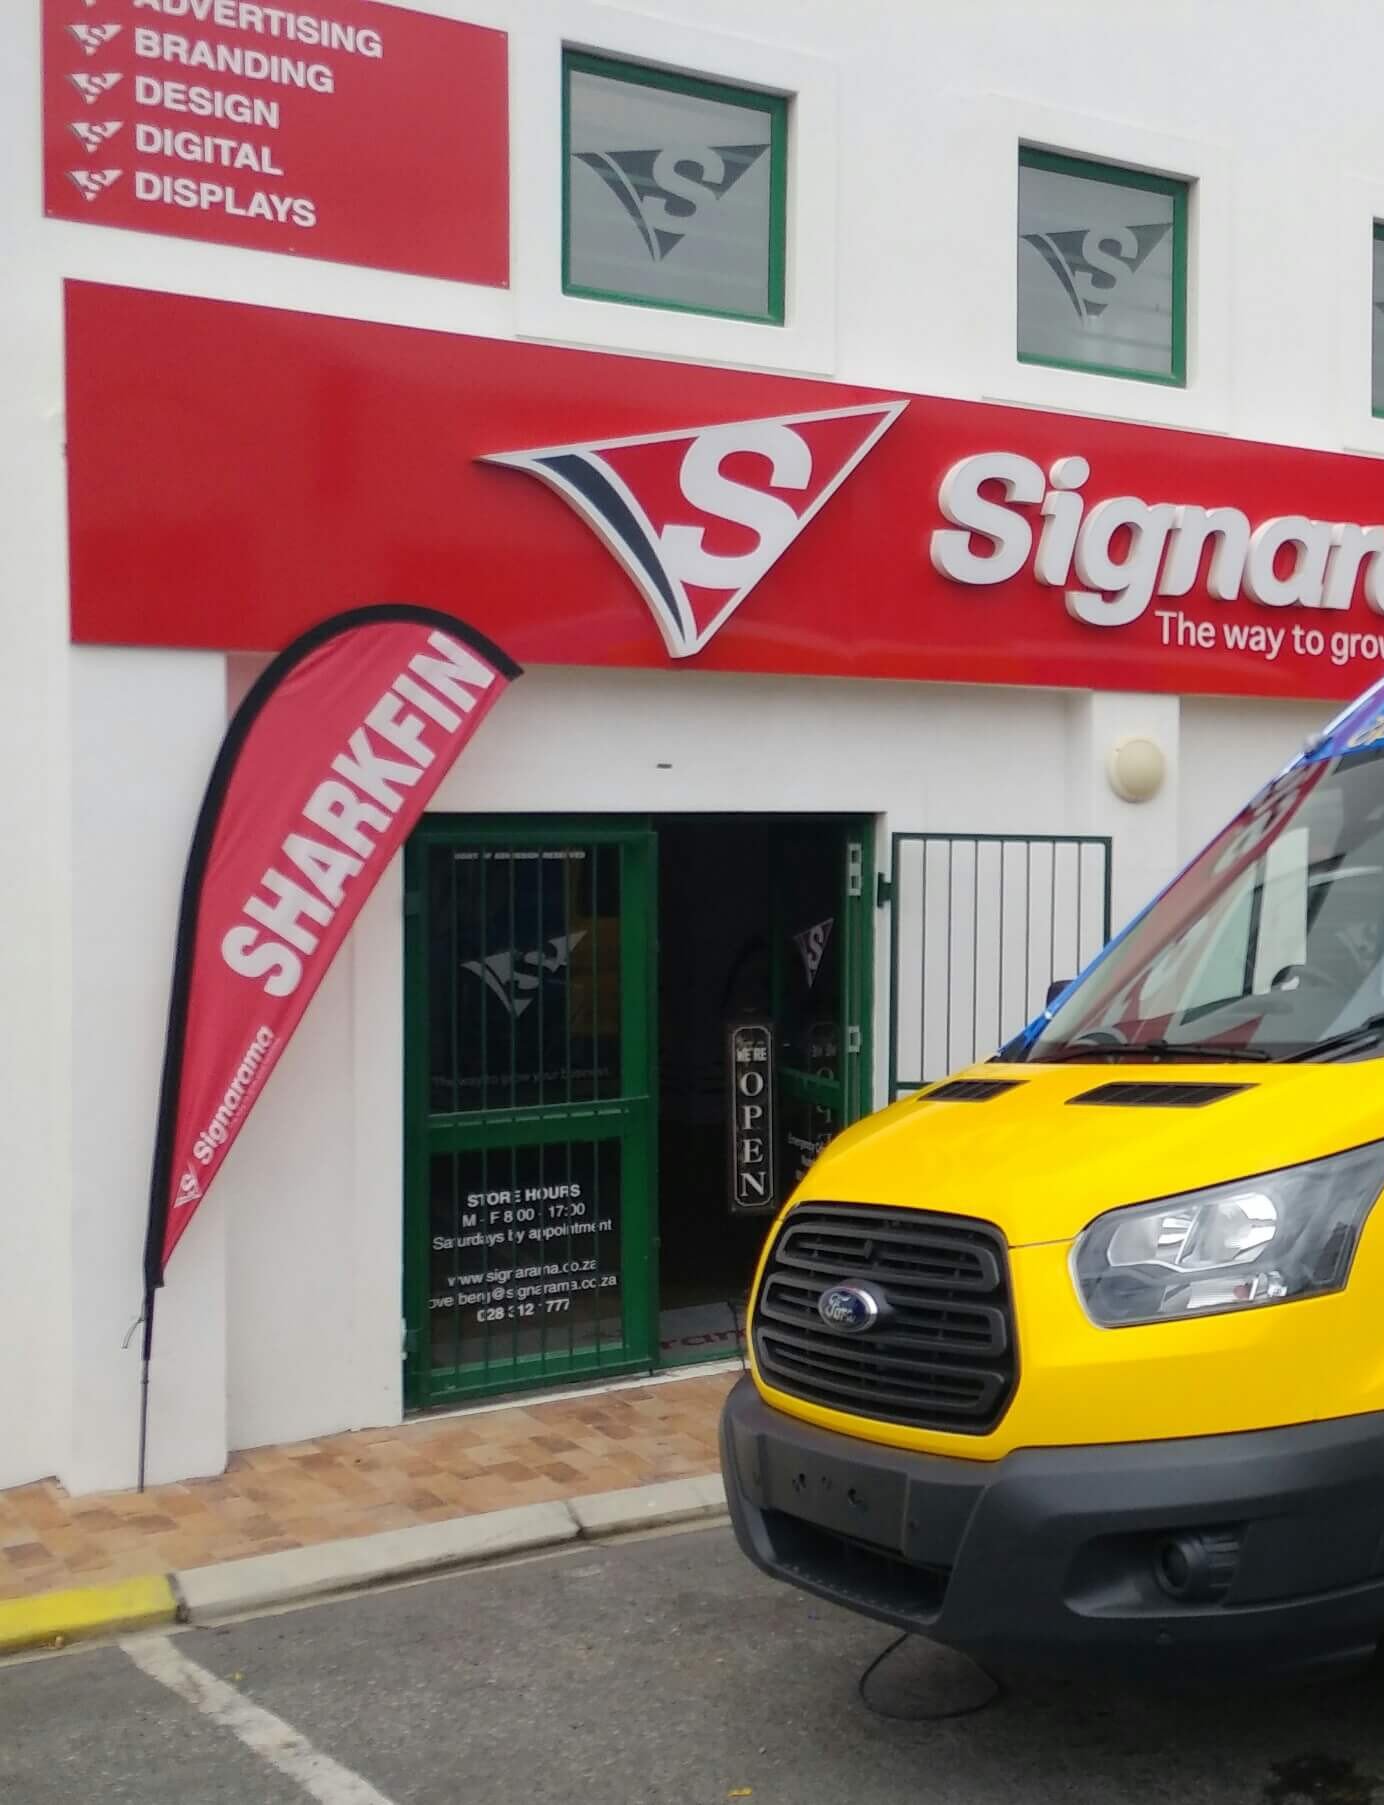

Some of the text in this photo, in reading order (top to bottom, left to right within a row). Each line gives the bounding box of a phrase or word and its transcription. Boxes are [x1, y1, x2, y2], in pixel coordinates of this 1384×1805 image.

[134, 27, 335, 94] BRANDING
[134, 75, 280, 129] DESIGN
[134, 123, 285, 176] DIGITAL
[134, 170, 317, 228] DISPLAYS
[1154, 610, 1216, 648] The
[1222, 623, 1284, 661] way
[1291, 624, 1325, 657] to
[221, 630, 496, 998] SHARKFIN
[193, 1025, 274, 1166] Signarama
[739, 1071, 767, 1198] OPEN
[432, 1233, 505, 1251] Saurdays
[462, 1213, 477, 1228] M
[489, 1211, 501, 1225] F
[538, 1299, 570, 1313] 777
